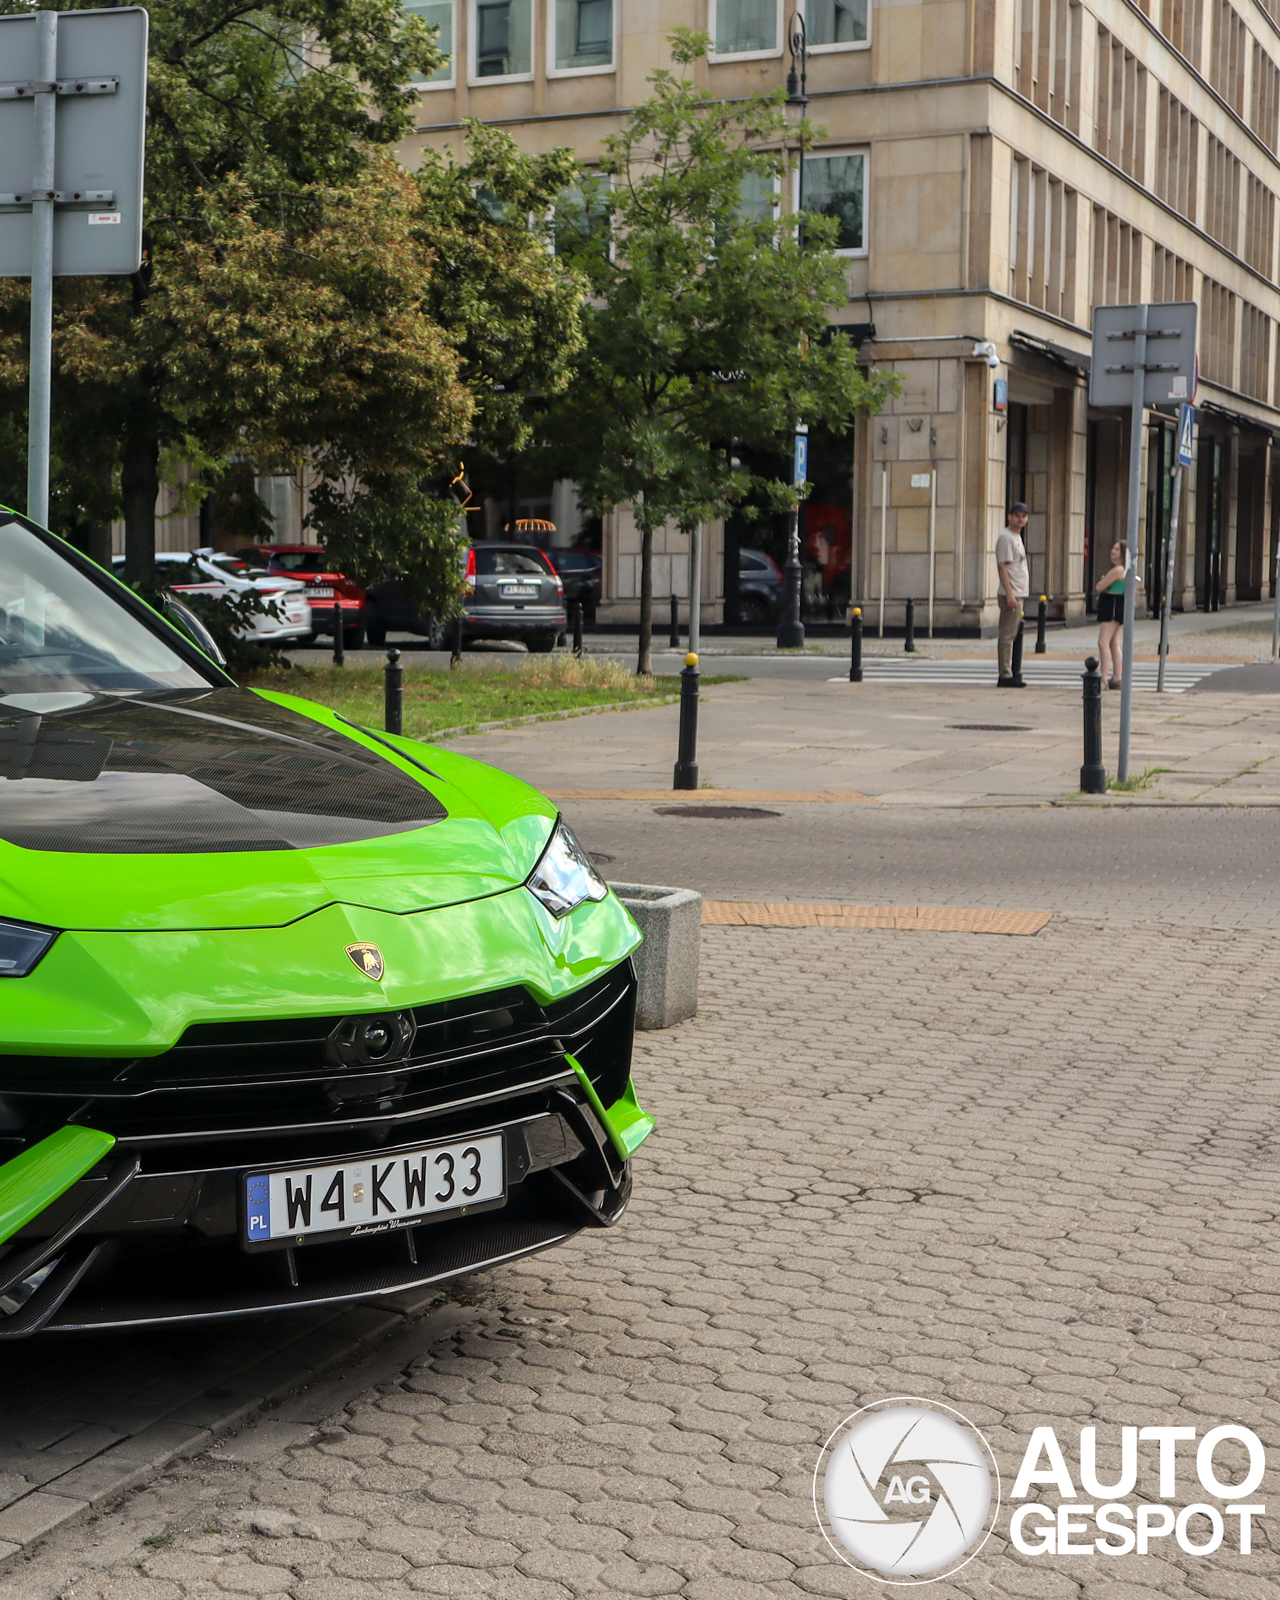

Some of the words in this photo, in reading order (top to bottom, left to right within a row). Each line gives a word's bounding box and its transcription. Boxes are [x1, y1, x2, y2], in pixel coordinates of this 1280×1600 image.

[285, 1169, 345, 1229] W4
[371, 1146, 482, 1216] KW33
[249, 1214, 267, 1231] PL
